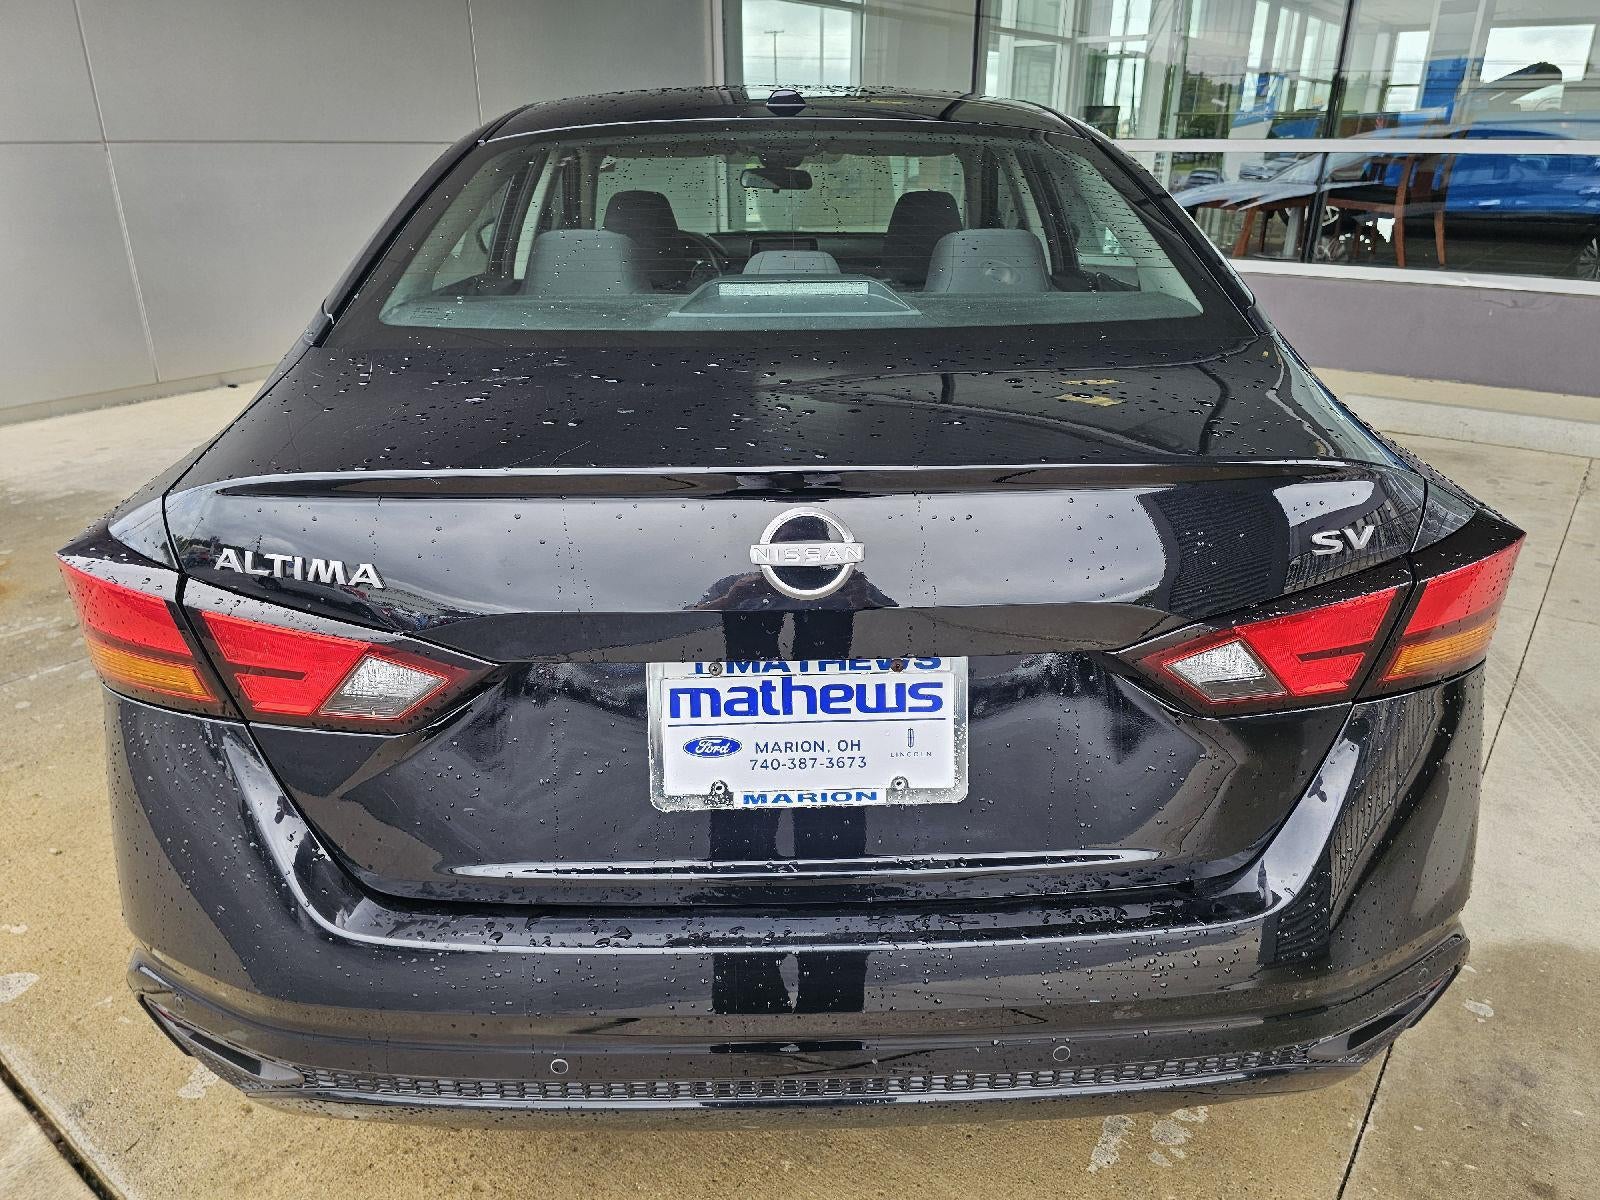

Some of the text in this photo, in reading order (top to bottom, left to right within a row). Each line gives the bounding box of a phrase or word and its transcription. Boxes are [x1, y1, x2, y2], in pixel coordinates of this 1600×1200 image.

[1311, 525, 1375, 556] SV
[752, 545, 862, 562] NISSAN
[213, 547, 386, 590] ALTIMA
[669, 676, 943, 719] mathews
[696, 738, 730, 754] Ford
[755, 739, 862, 754] MARION, OH
[750, 756, 867, 771] 740-387-3673
[743, 791, 877, 805] MARION
